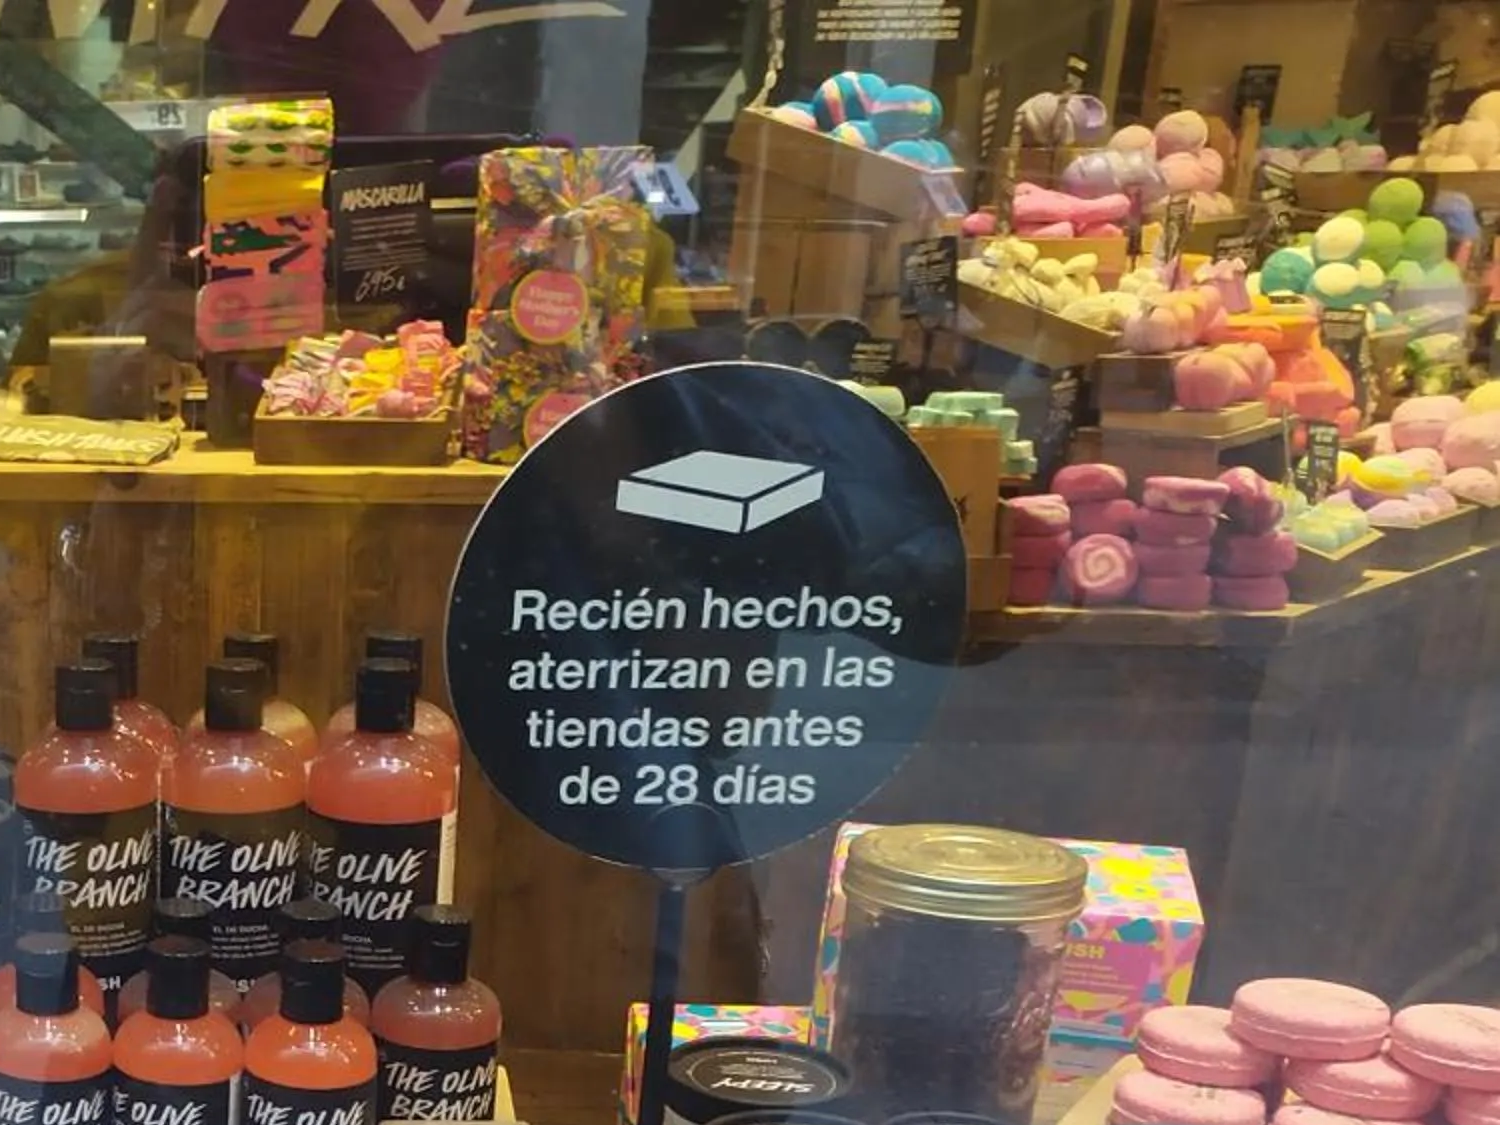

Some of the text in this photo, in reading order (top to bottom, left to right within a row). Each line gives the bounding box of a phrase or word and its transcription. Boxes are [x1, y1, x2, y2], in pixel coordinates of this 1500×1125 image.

[340, 182, 425, 212] MASCARILLA
[511, 586, 904, 635] Recién hechos,
[508, 647, 895, 691] aterrizan en las
[526, 708, 864, 749] tiendas antes
[559, 764, 816, 805] de 28 días
[25, 836, 82, 873] THE
[169, 835, 227, 873] THE
[337, 848, 428, 885] OLIVE
[176, 871, 297, 910] BRANCH
[97, 976, 121, 991] SH
[385, 1061, 439, 1093] THE
[391, 1088, 493, 1121] BRANCH
